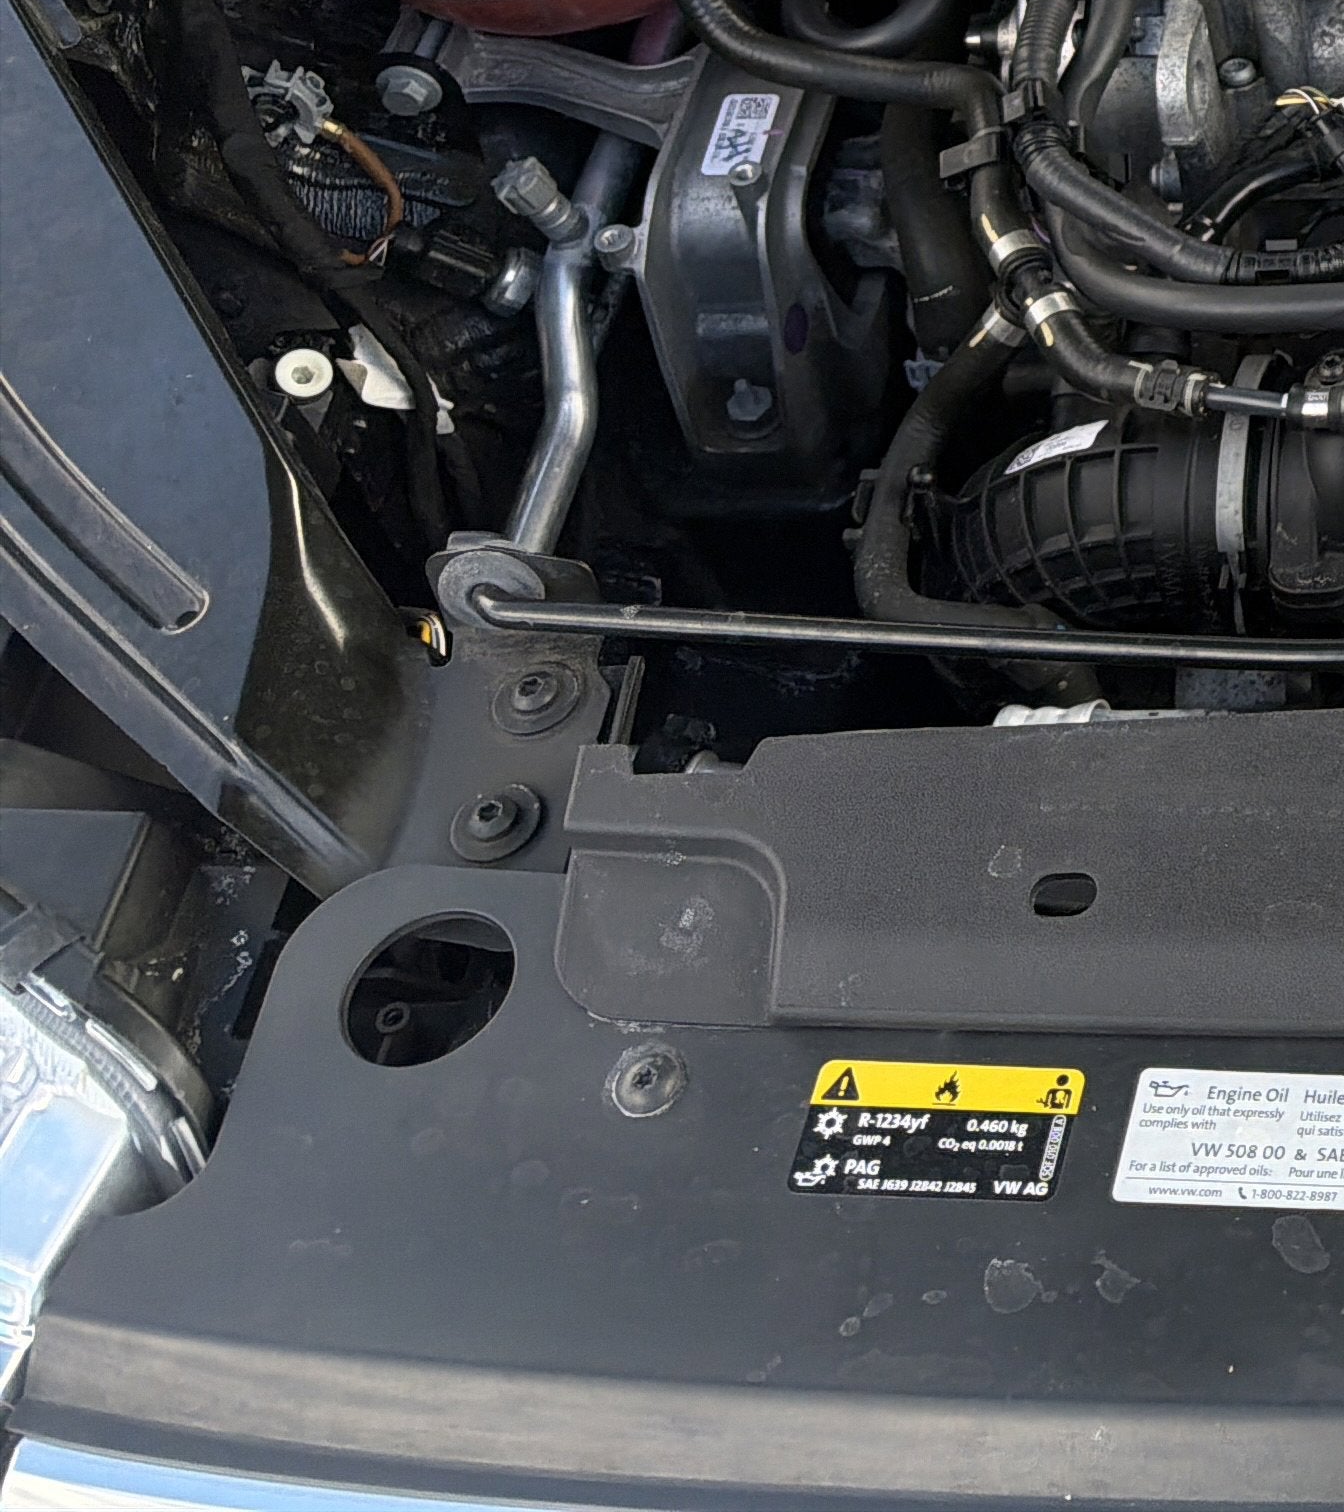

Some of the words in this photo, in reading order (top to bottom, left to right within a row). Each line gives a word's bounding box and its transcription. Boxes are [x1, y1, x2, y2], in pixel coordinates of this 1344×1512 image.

[1206, 1085, 1262, 1105] Engine
[1265, 1087, 1289, 1102] Oil
[1142, 1102, 1164, 1114] Use
[1165, 1103, 1190, 1118] only
[1191, 1104, 1206, 1115] oil
[1207, 1104, 1231, 1117] that
[1232, 1107, 1285, 1121] expressly
[1299, 1110, 1342, 1123] Utilisez
[857, 1112, 931, 1134] R-1234yf
[966, 1118, 1009, 1133] 0.460
[1009, 1119, 1029, 1138] kg
[1138, 1117, 1188, 1130] complies
[1190, 1118, 1216, 1130] with
[1296, 1124, 1315, 1137] qui
[852, 1134, 882, 1145] GWP
[881, 1135, 891, 1146] 4
[960, 1140, 977, 1152] eq
[977, 1139, 1016, 1153] 0.0018
[1016, 1140, 1024, 1151] t
[1191, 1142, 1223, 1157] VW
[1224, 1143, 1258, 1159] 508
[1262, 1145, 1286, 1160] 00
[1293, 1148, 1307, 1161] &
[843, 1158, 881, 1175] PAG
[1128, 1159, 1148, 1171] For
[1148, 1162, 1156, 1172] a
[1158, 1160, 1177, 1173] list
[1178, 1161, 1193, 1173] of
[1192, 1163, 1247, 1177] approved
[1287, 1166, 1315, 1178] Pour
[1316, 1170, 1338, 1179] une
[856, 1177, 880, 1190] SAE
[993, 1180, 1022, 1194] VW
[1022, 1181, 1048, 1196] AG
[1148, 1186, 1222, 1197] www.vw.com
[1252, 1188, 1338, 1202] 1-800-822-8987
